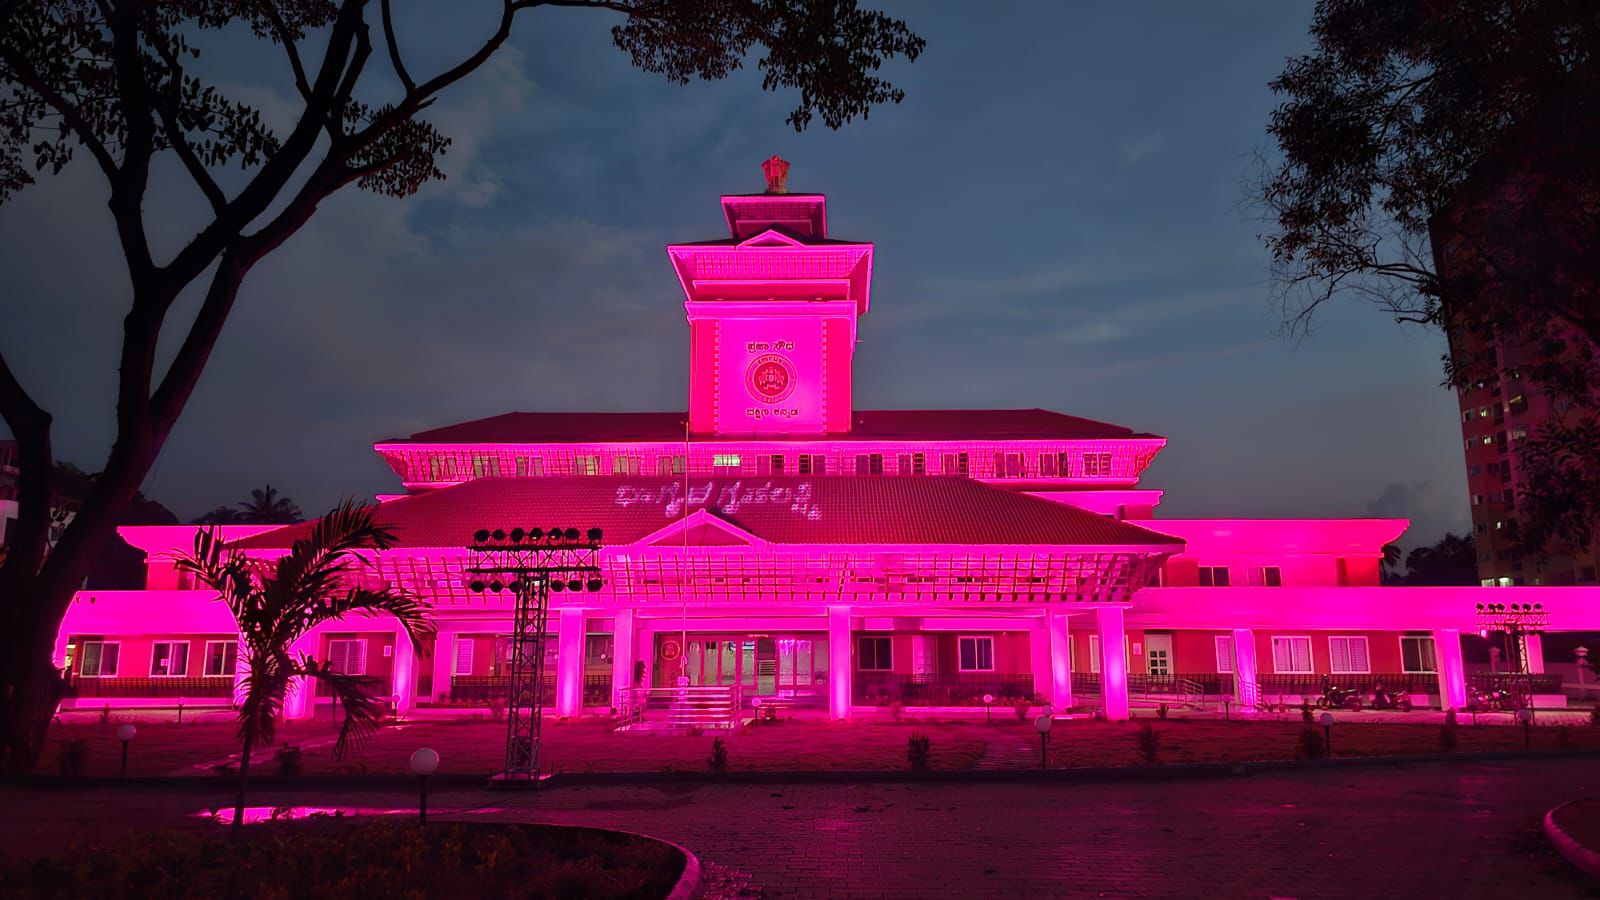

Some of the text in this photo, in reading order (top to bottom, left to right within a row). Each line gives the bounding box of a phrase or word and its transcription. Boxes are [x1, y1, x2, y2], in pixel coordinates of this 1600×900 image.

[747, 340, 794, 354] ಪ್ರಜಾ ಸೌಧ
[746, 407, 799, 419] ದಕ್ಷಿಣ ಕನ್ನಡ
